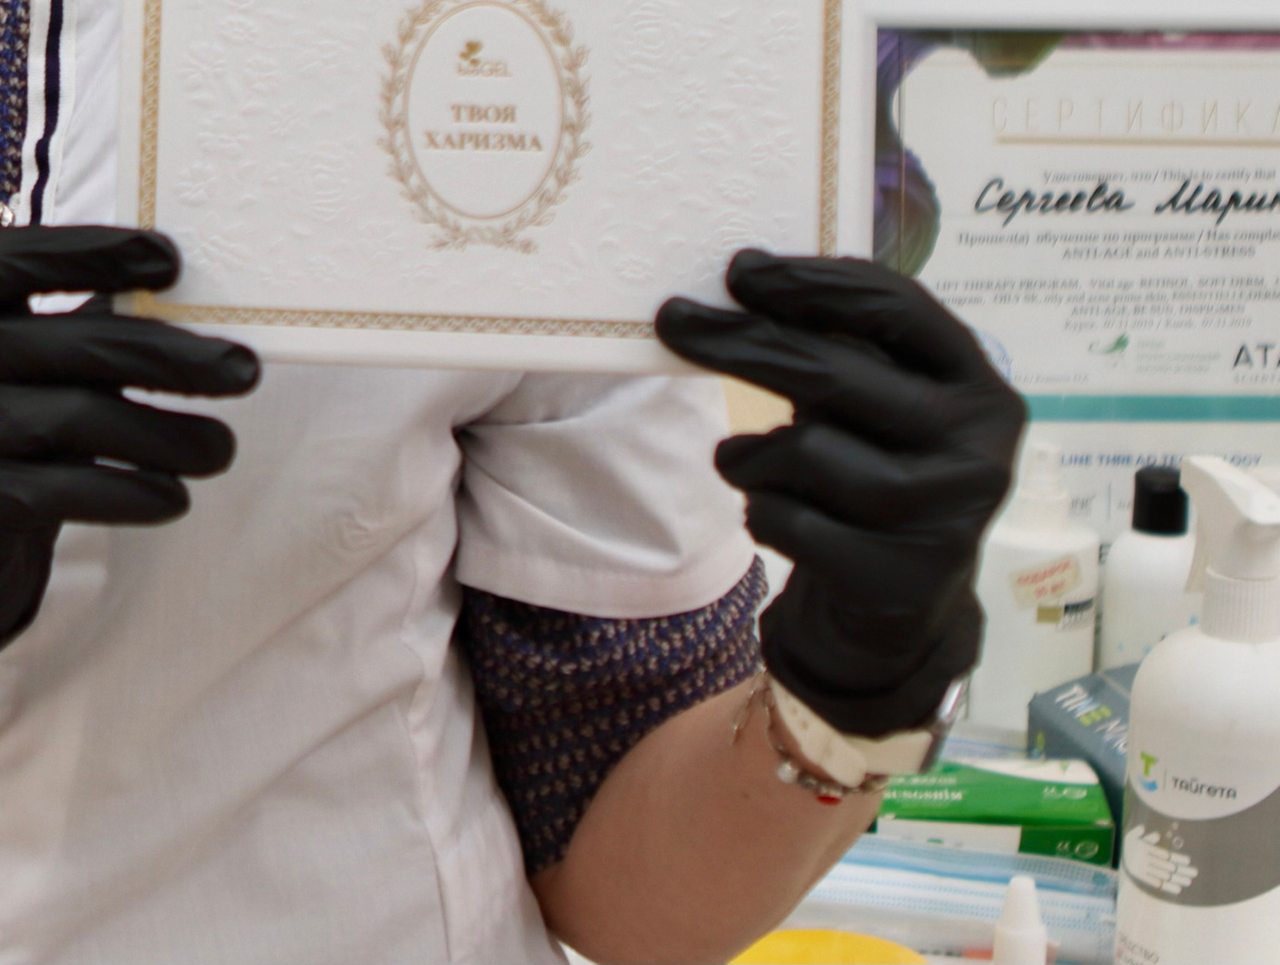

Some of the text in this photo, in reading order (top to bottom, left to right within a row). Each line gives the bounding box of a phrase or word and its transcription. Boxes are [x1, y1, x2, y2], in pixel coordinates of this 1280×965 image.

[451, 104, 517, 123] ТВОЯ
[424, 132, 543, 151] ХАРИЗМА
[974, 177, 1135, 228] Сергеева
[1233, 344, 1280, 369] AT
